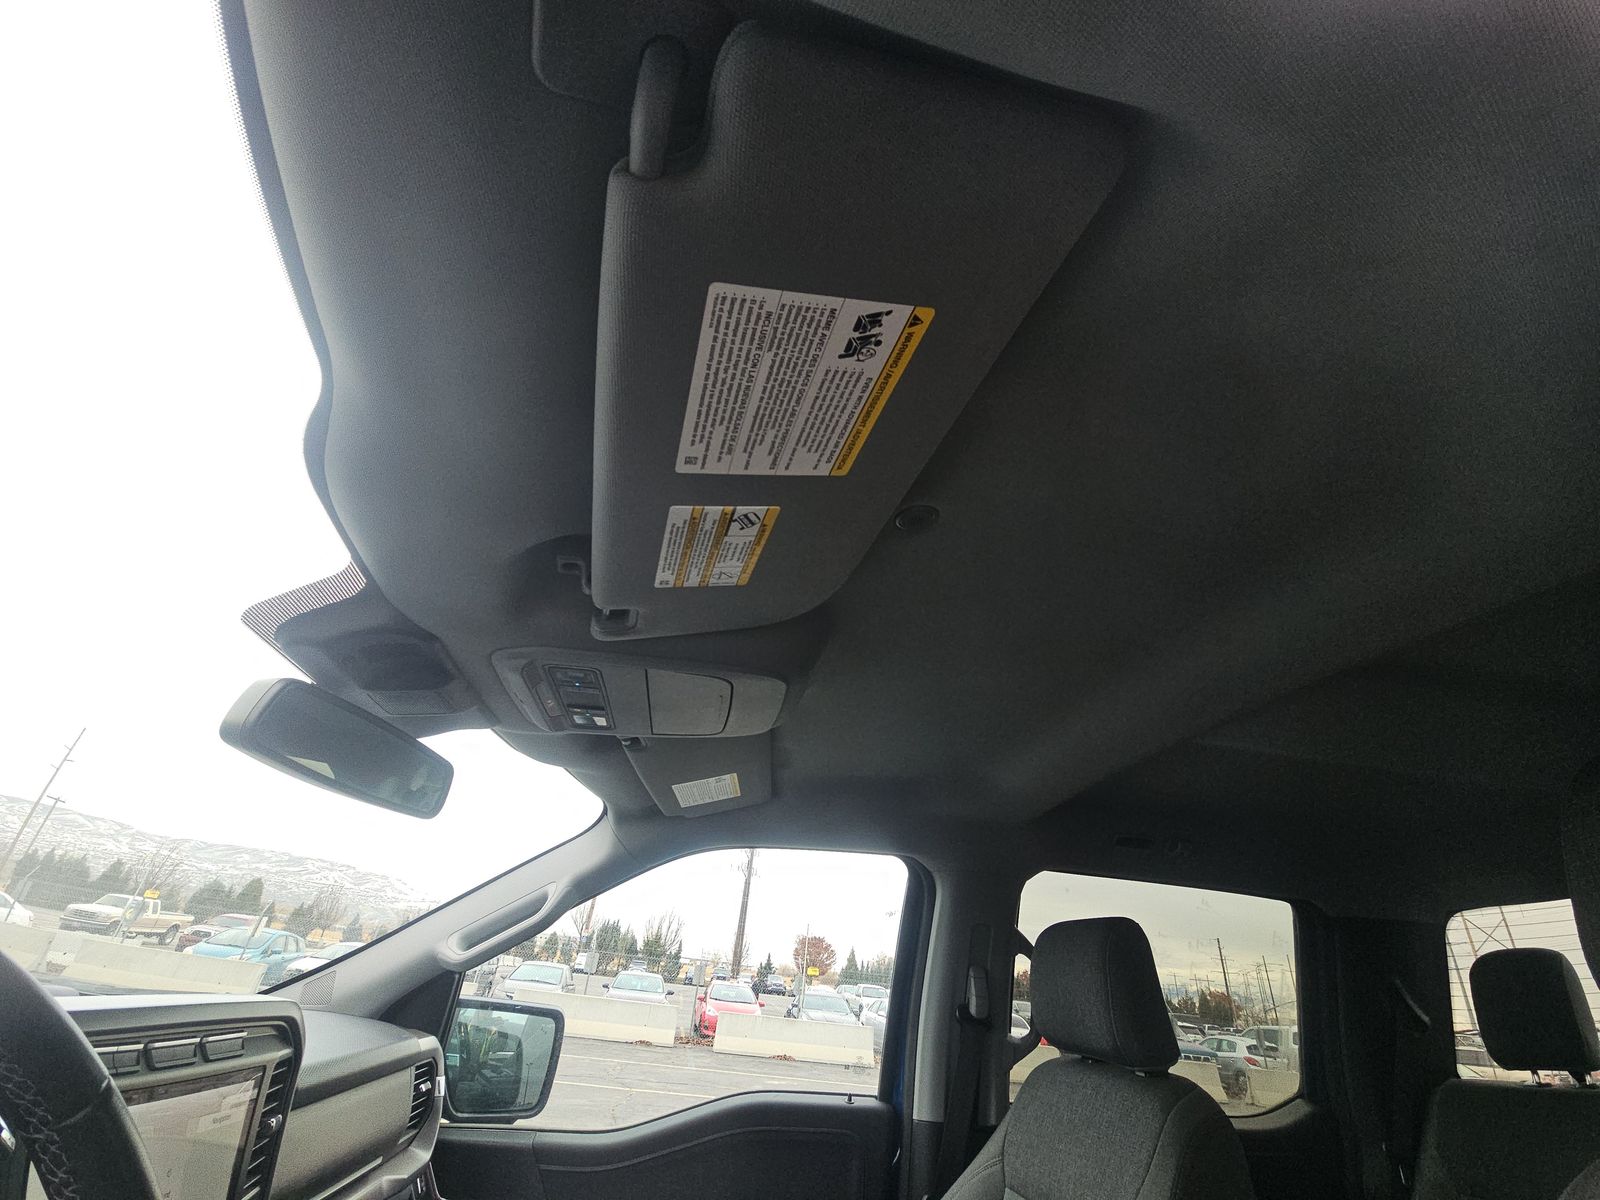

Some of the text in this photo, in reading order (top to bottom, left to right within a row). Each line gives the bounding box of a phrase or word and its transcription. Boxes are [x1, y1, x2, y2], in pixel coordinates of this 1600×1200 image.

[755, 311, 774, 351] INCLUSIVE
[822, 308, 838, 331] MÊME
[814, 332, 828, 352] AVEC
[889, 331, 915, 368] WARNING
[750, 353, 761, 368] CON
[808, 354, 820, 368] DES
[746, 370, 756, 383] LAS
[800, 369, 814, 387] SACS
[860, 378, 873, 394] EVEN
[738, 385, 752, 410] NUEVAS
[785, 388, 806, 427] GONFLABLES
[858, 373, 894, 428] AVERTISSEMENT
[731, 411, 744, 434] BOLSAS
[837, 410, 857, 440] ADVANCED
